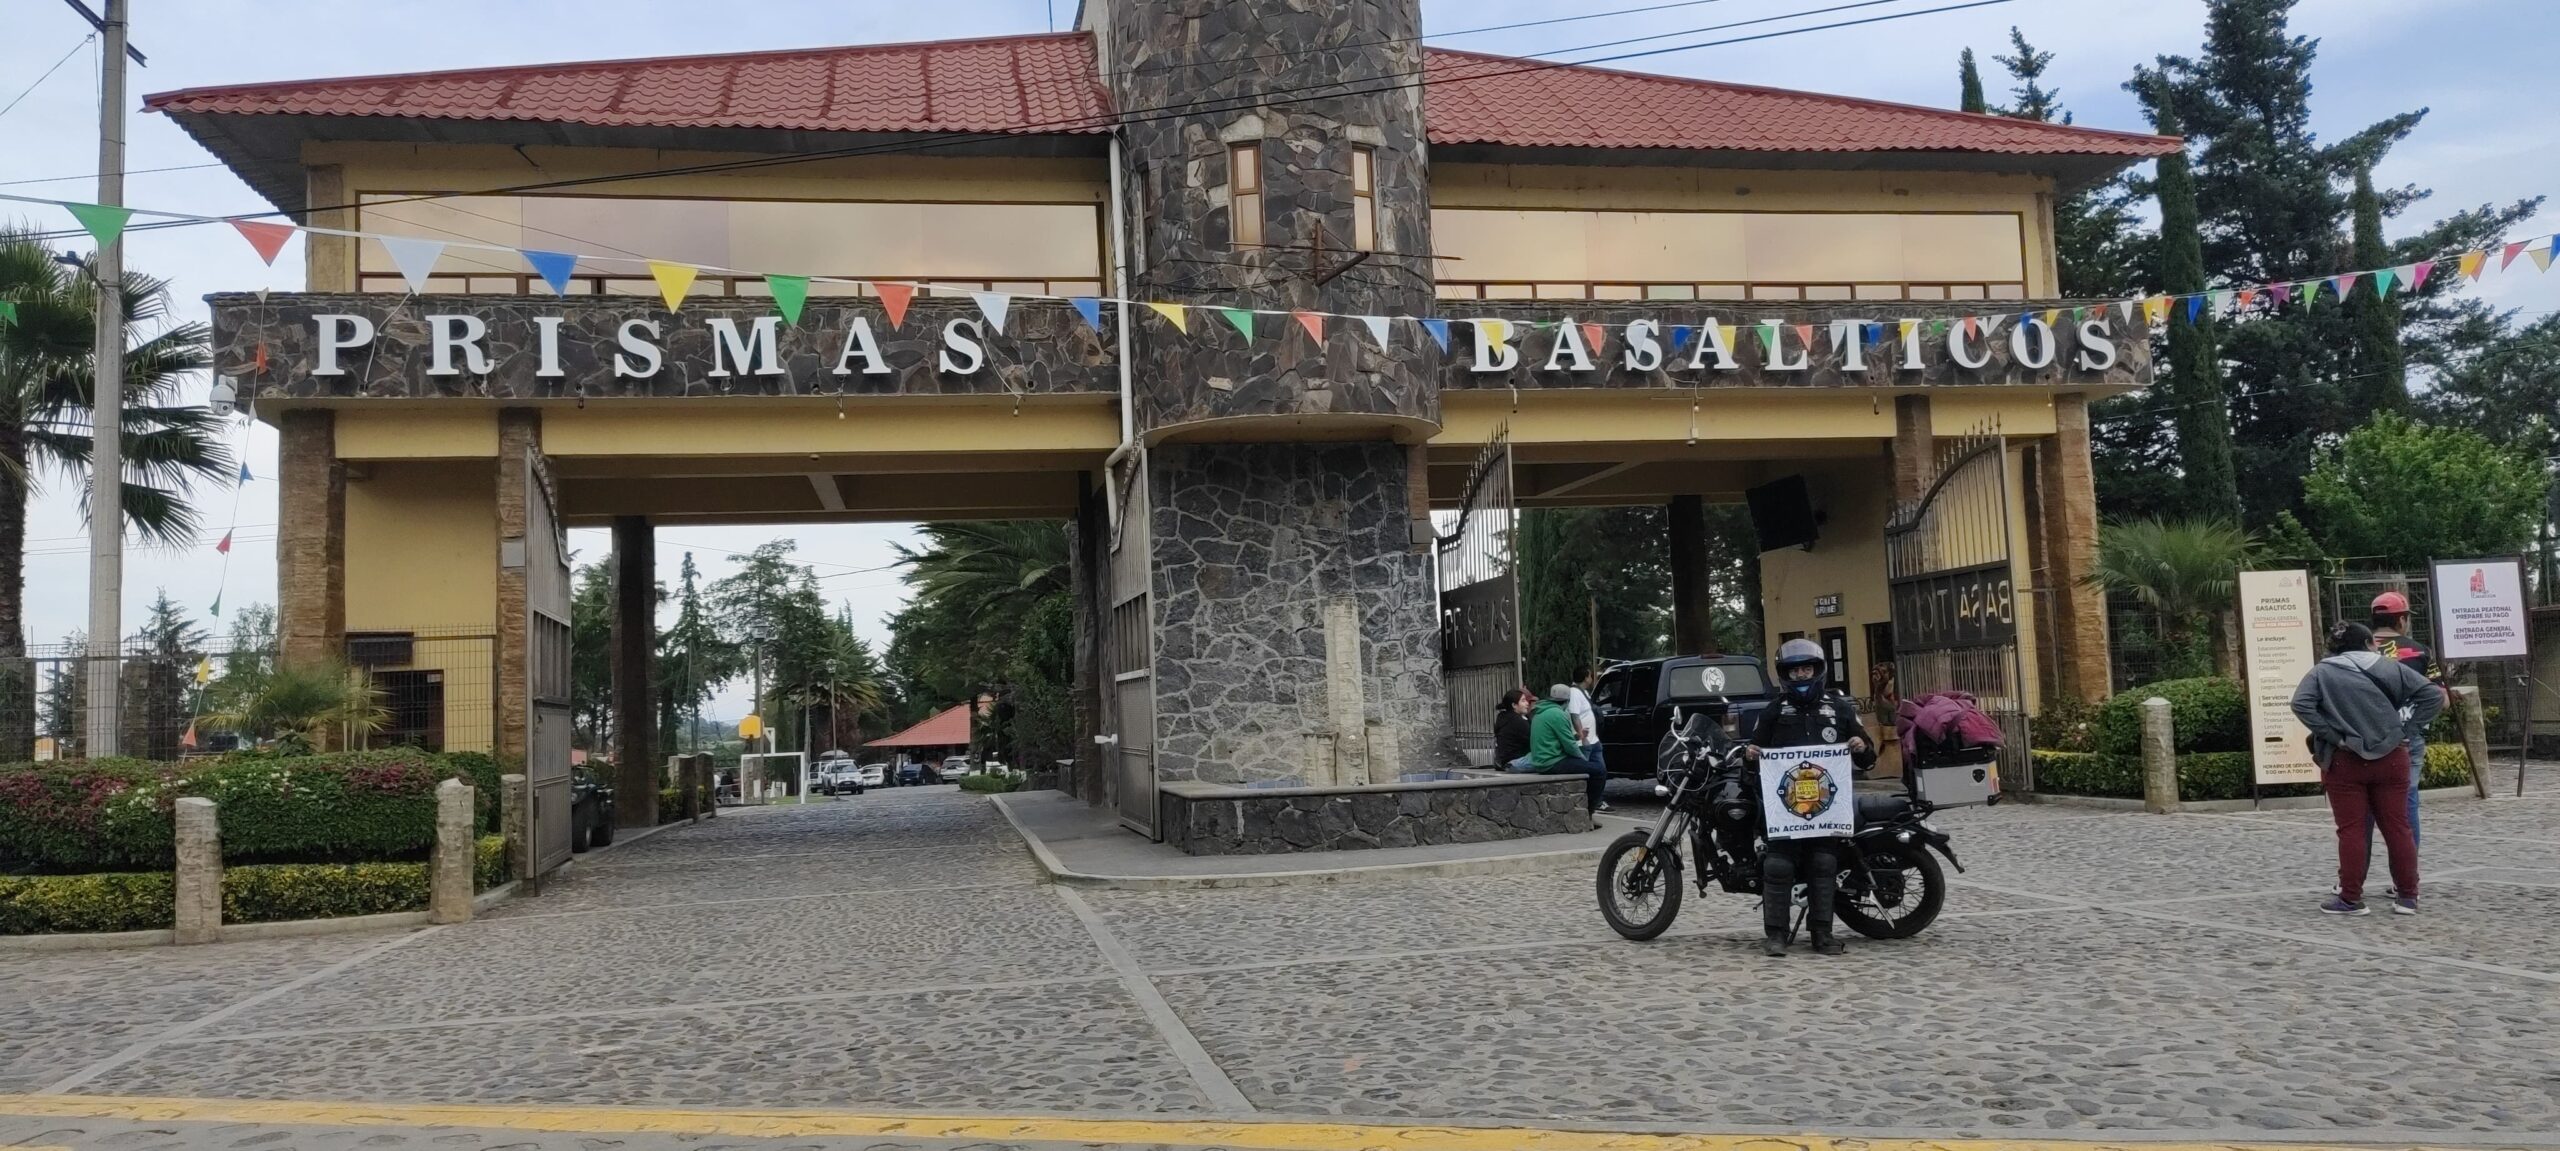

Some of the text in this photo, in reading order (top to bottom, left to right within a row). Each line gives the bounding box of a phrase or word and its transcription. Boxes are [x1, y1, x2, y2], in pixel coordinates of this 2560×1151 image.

[311, 314, 985, 377] PRISMAS
[1471, 316, 2119, 373] BASALTICOS
[2255, 604, 2297, 612] BASALTICOS
[1760, 748, 1850, 760] MOTOTURISMO
[1769, 821, 1852, 834] EN ACCIÓN MÉXICO
